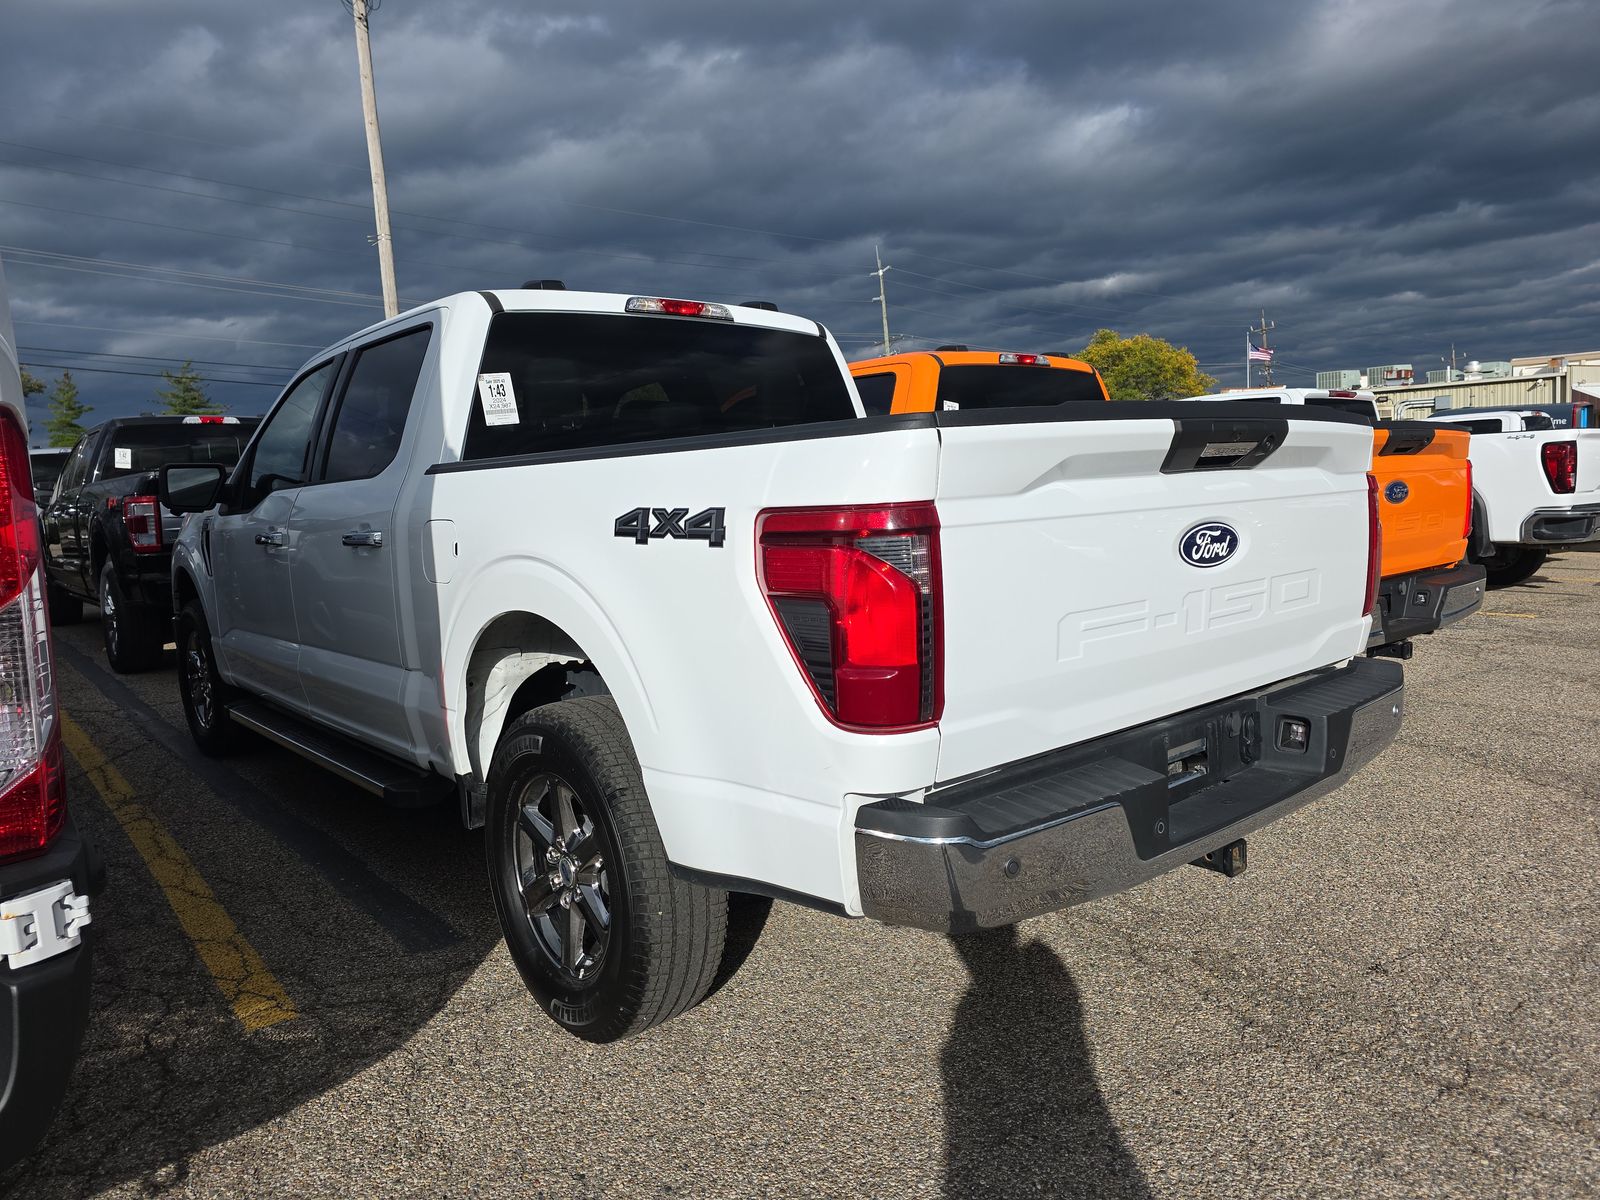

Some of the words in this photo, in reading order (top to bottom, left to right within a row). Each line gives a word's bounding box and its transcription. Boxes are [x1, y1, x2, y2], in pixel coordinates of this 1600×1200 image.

[488, 383, 506, 398] 1:43
[1192, 529, 1230, 561] Ford
[1056, 568, 1322, 663] F-150
